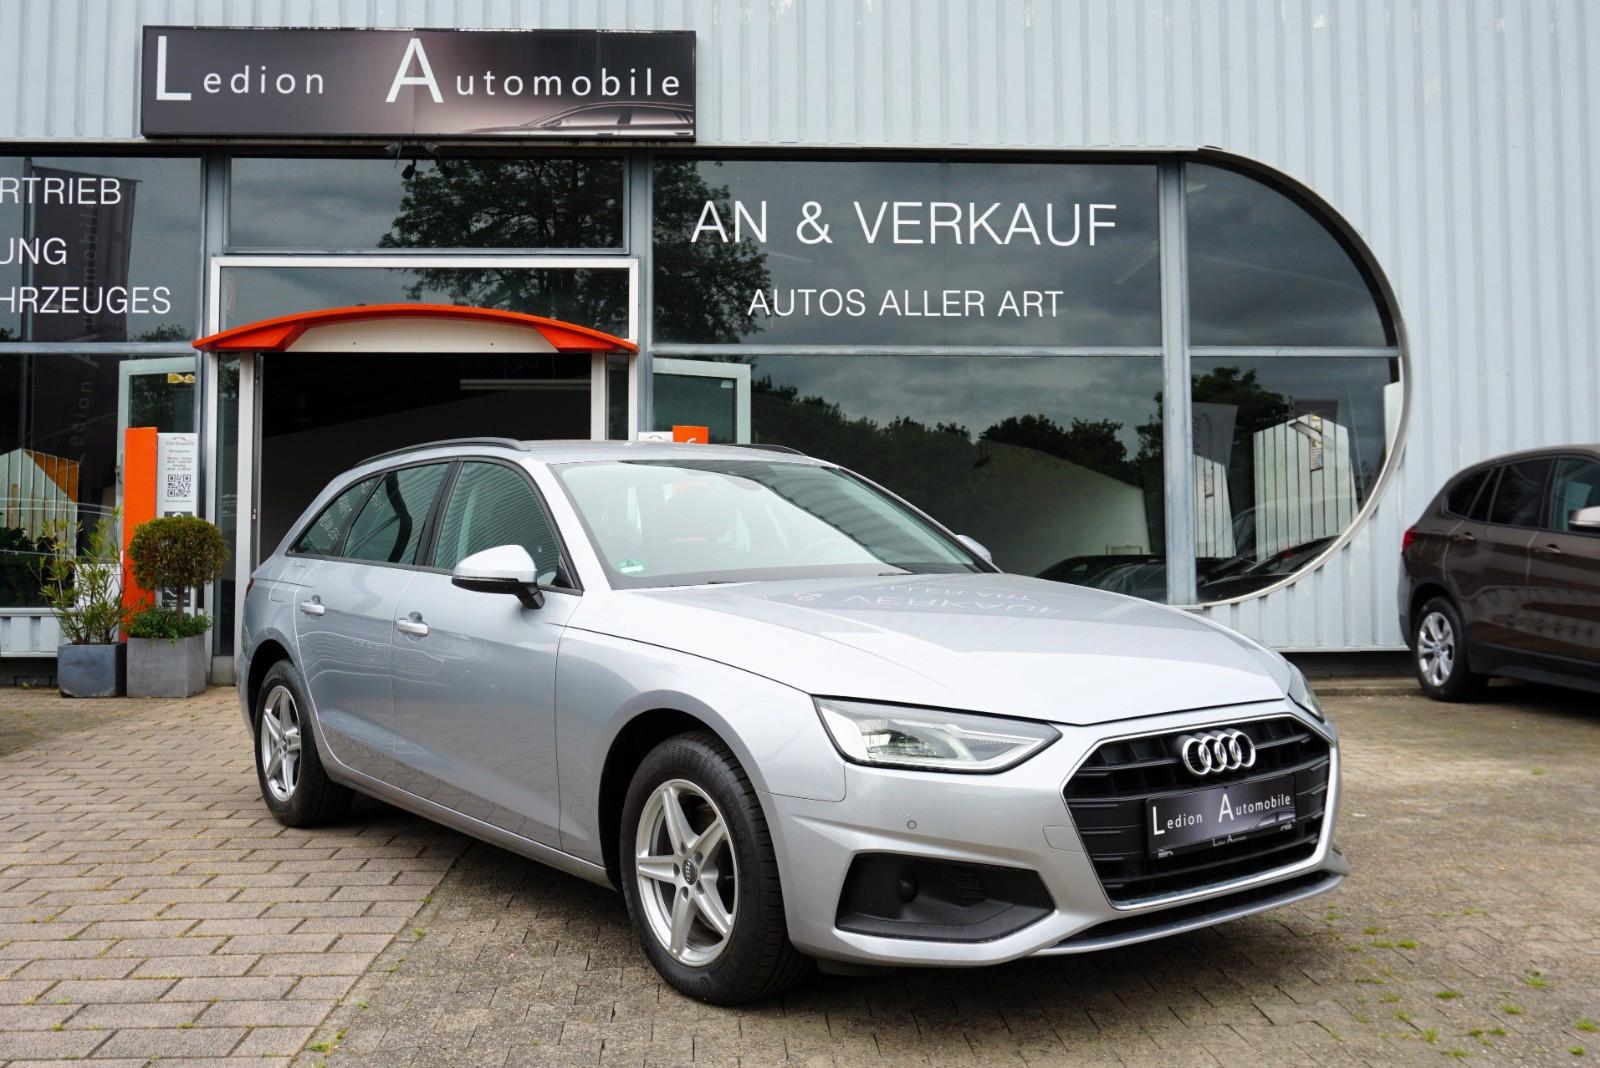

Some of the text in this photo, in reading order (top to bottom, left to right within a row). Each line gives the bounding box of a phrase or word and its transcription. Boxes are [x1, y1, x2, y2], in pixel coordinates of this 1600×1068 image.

[156, 35, 681, 104] Ledion Automobile
[0, 177, 122, 205] RTRIEB
[690, 200, 1118, 247] AN & VERKAUF
[0, 237, 67, 265] UNG
[747, 288, 1065, 318] AUTOS ALLER ART
[1152, 793, 1291, 835] Ledion Automobile
